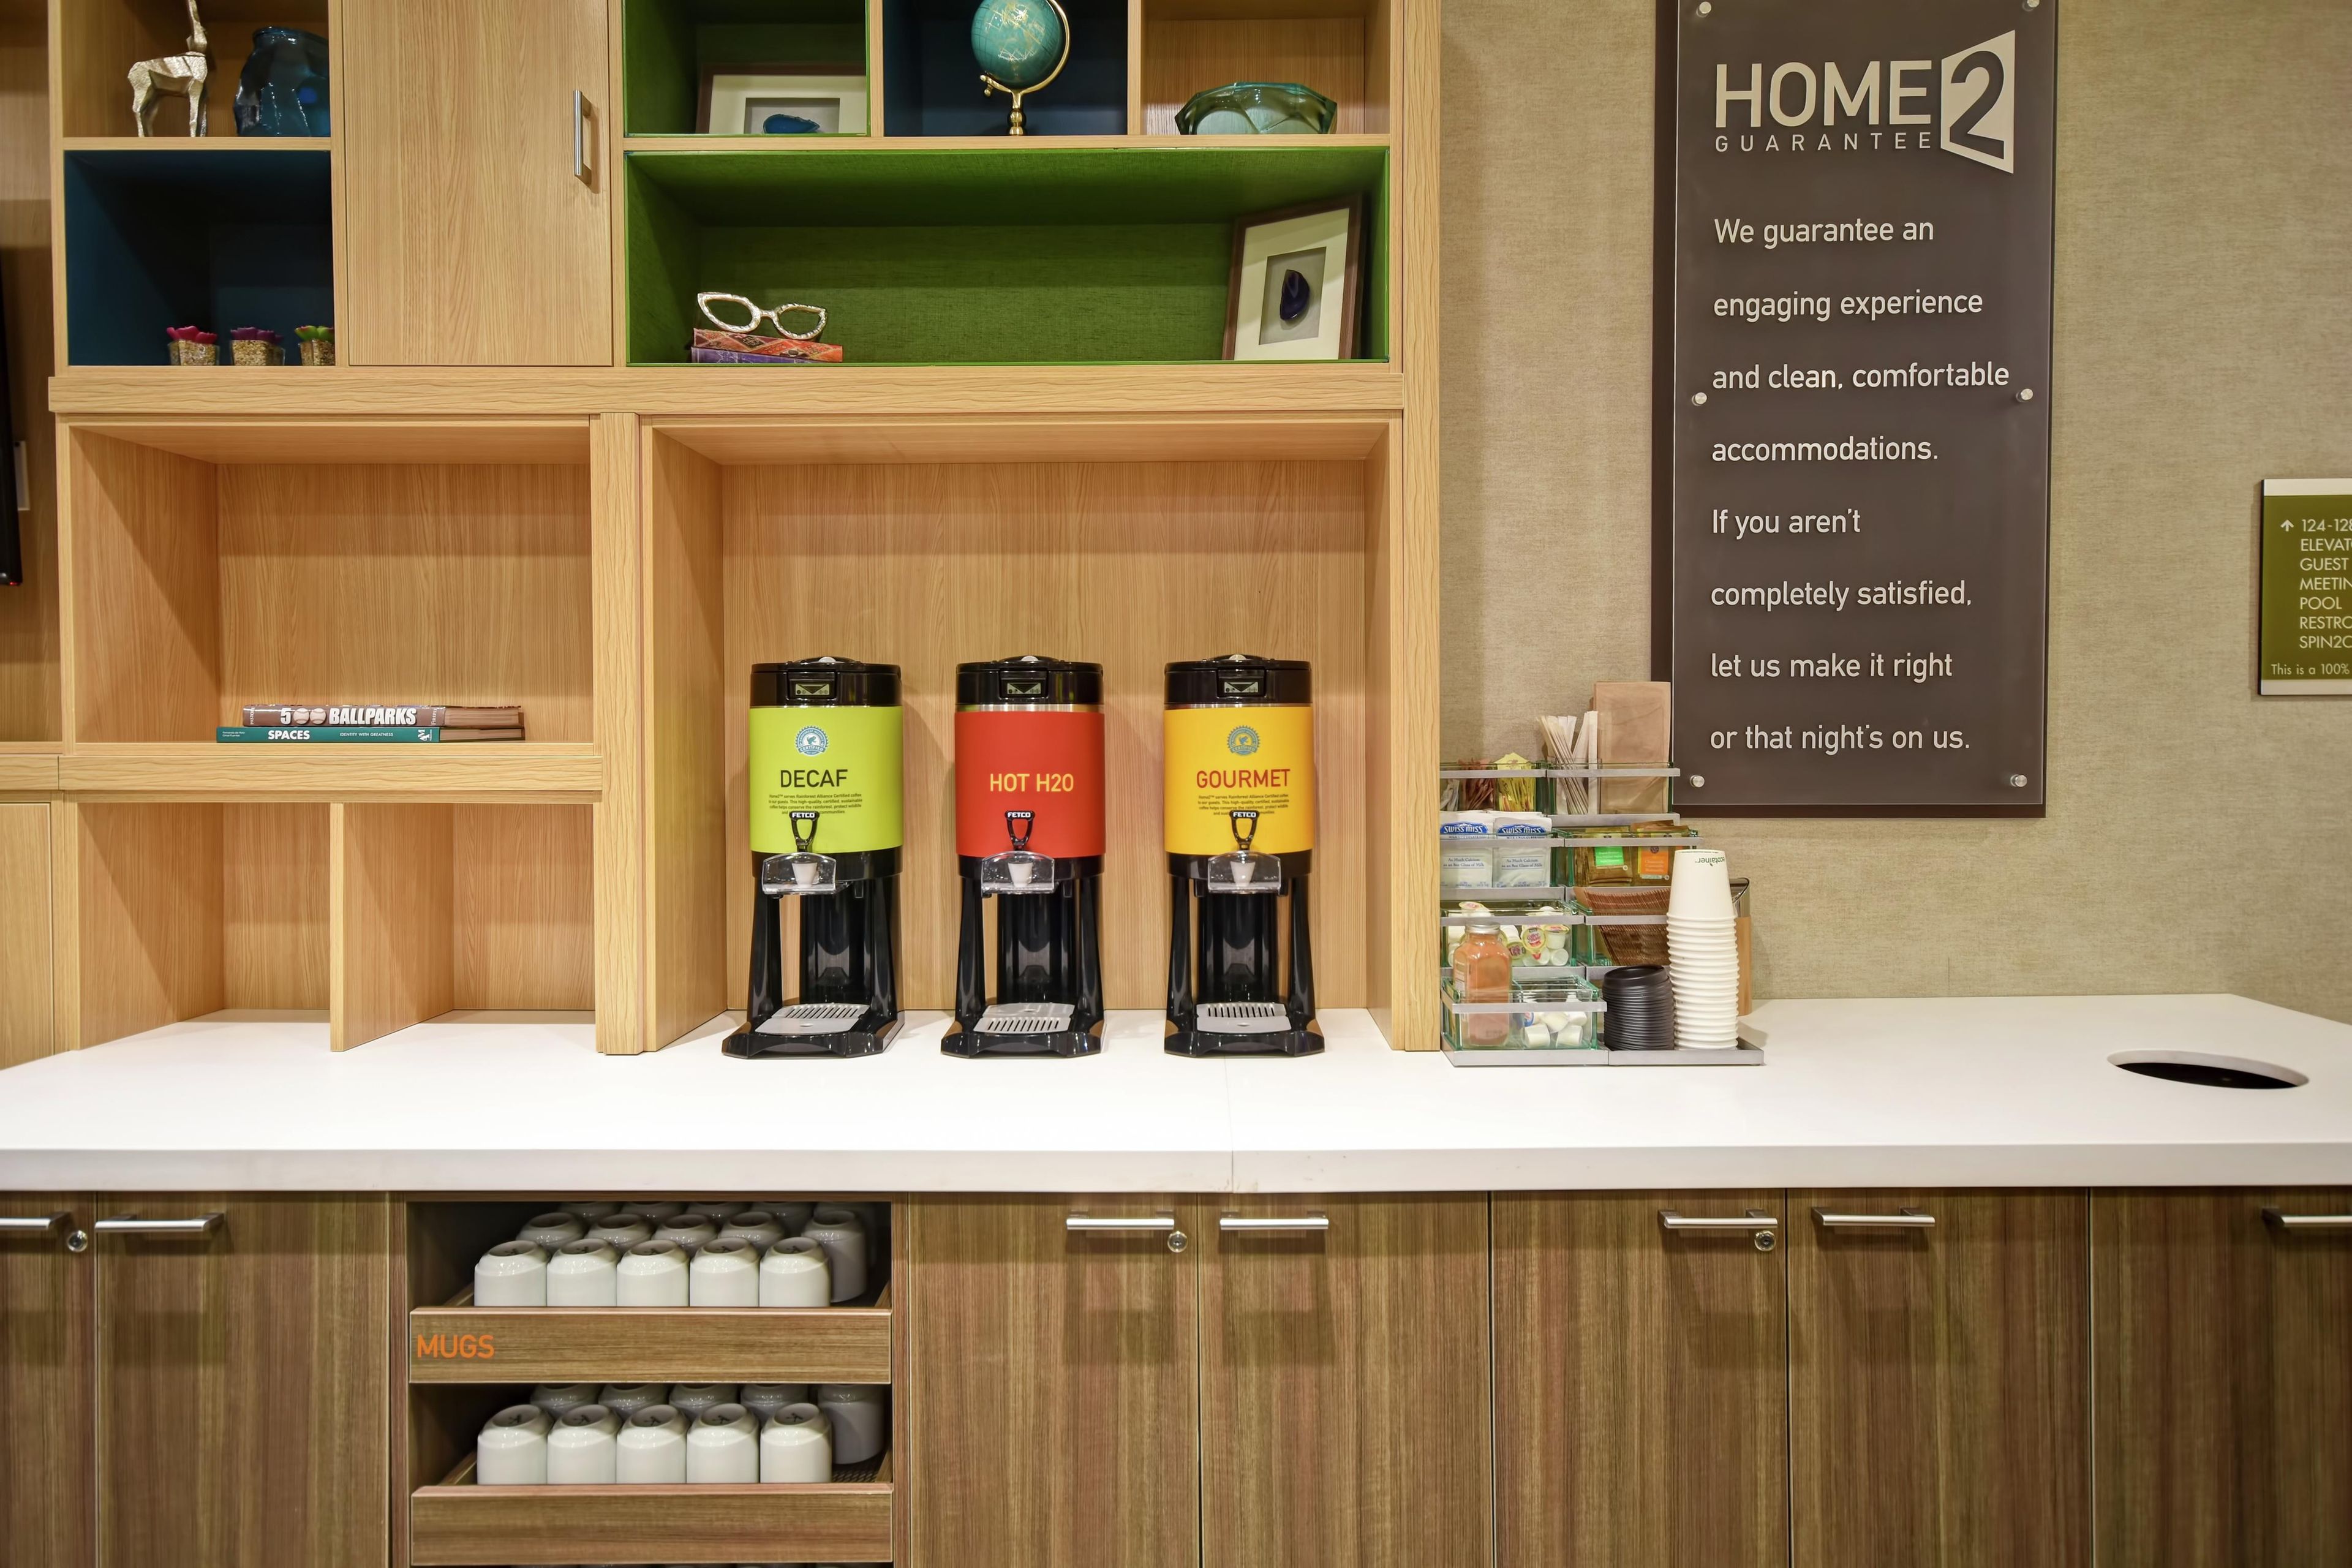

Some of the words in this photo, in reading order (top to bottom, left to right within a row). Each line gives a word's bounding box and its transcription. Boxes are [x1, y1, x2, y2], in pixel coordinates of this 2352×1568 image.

[1715, 132, 1931, 153] GUARANTEE
[1714, 218, 1754, 243] We
[1764, 218, 1894, 249] guarantee
[1902, 222, 1934, 241] an
[1714, 290, 1831, 323] engaging
[1841, 288, 1983, 321] experience
[1713, 364, 1759, 389] and
[1768, 364, 1842, 390] clean,
[1852, 361, 2009, 388] comfortable
[1712, 435, 1938, 461] accommodations.
[1713, 509, 1728, 533] If
[1735, 515, 1779, 540] you
[1789, 508, 1861, 533] aren't
[2301, 538, 2352, 551] ELEVAT
[2299, 558, 2350, 571] GUEST
[1711, 581, 1850, 612] completely
[1857, 579, 1971, 606] satisfied,
[2300, 597, 2343, 610] POOL
[1711, 653, 1741, 677] let
[1751, 659, 1781, 677] us
[1790, 652, 1860, 677] make
[1871, 652, 1884, 677] it
[1894, 652, 1953, 684] right
[2271, 662, 2292, 675] This
[2296, 664, 2304, 675] is
[2321, 663, 2350, 675] 100%
[329, 707, 417, 725] BALLPARKS
[268, 729, 311, 740] SPACES
[1711, 731, 1738, 749] or
[1745, 725, 1792, 749] that
[1802, 724, 1883, 755] night's
[1893, 731, 1923, 748] on
[1934, 731, 1969, 748] us.
[780, 769, 848, 788] DECAF
[990, 773, 1030, 792] HOT
[1196, 768, 1291, 789] GOURMET
[417, 1333, 495, 1359] MUGS
